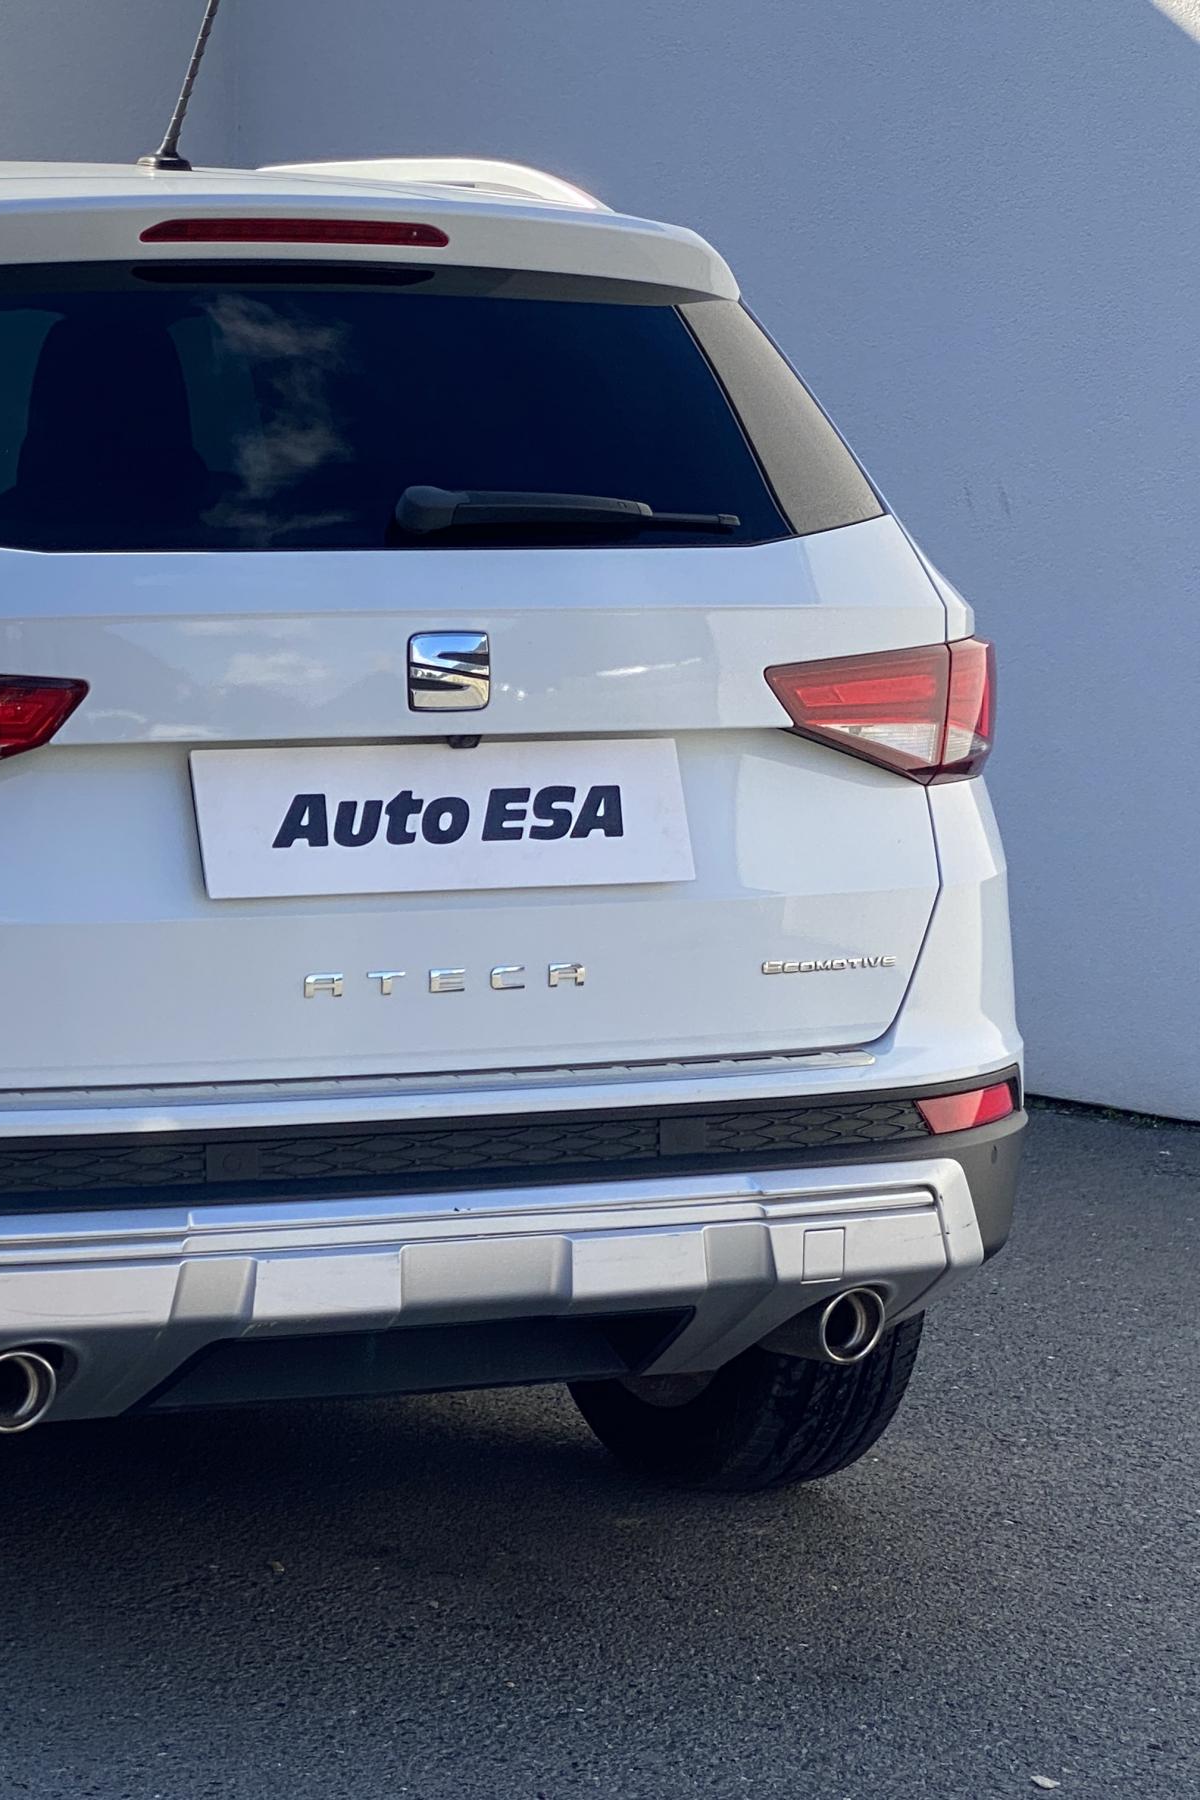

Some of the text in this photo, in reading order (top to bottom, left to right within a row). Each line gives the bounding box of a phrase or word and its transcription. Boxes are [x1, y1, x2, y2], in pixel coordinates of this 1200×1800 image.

[272, 785, 624, 849] Auto ESA
[302, 963, 587, 998] ATECA
